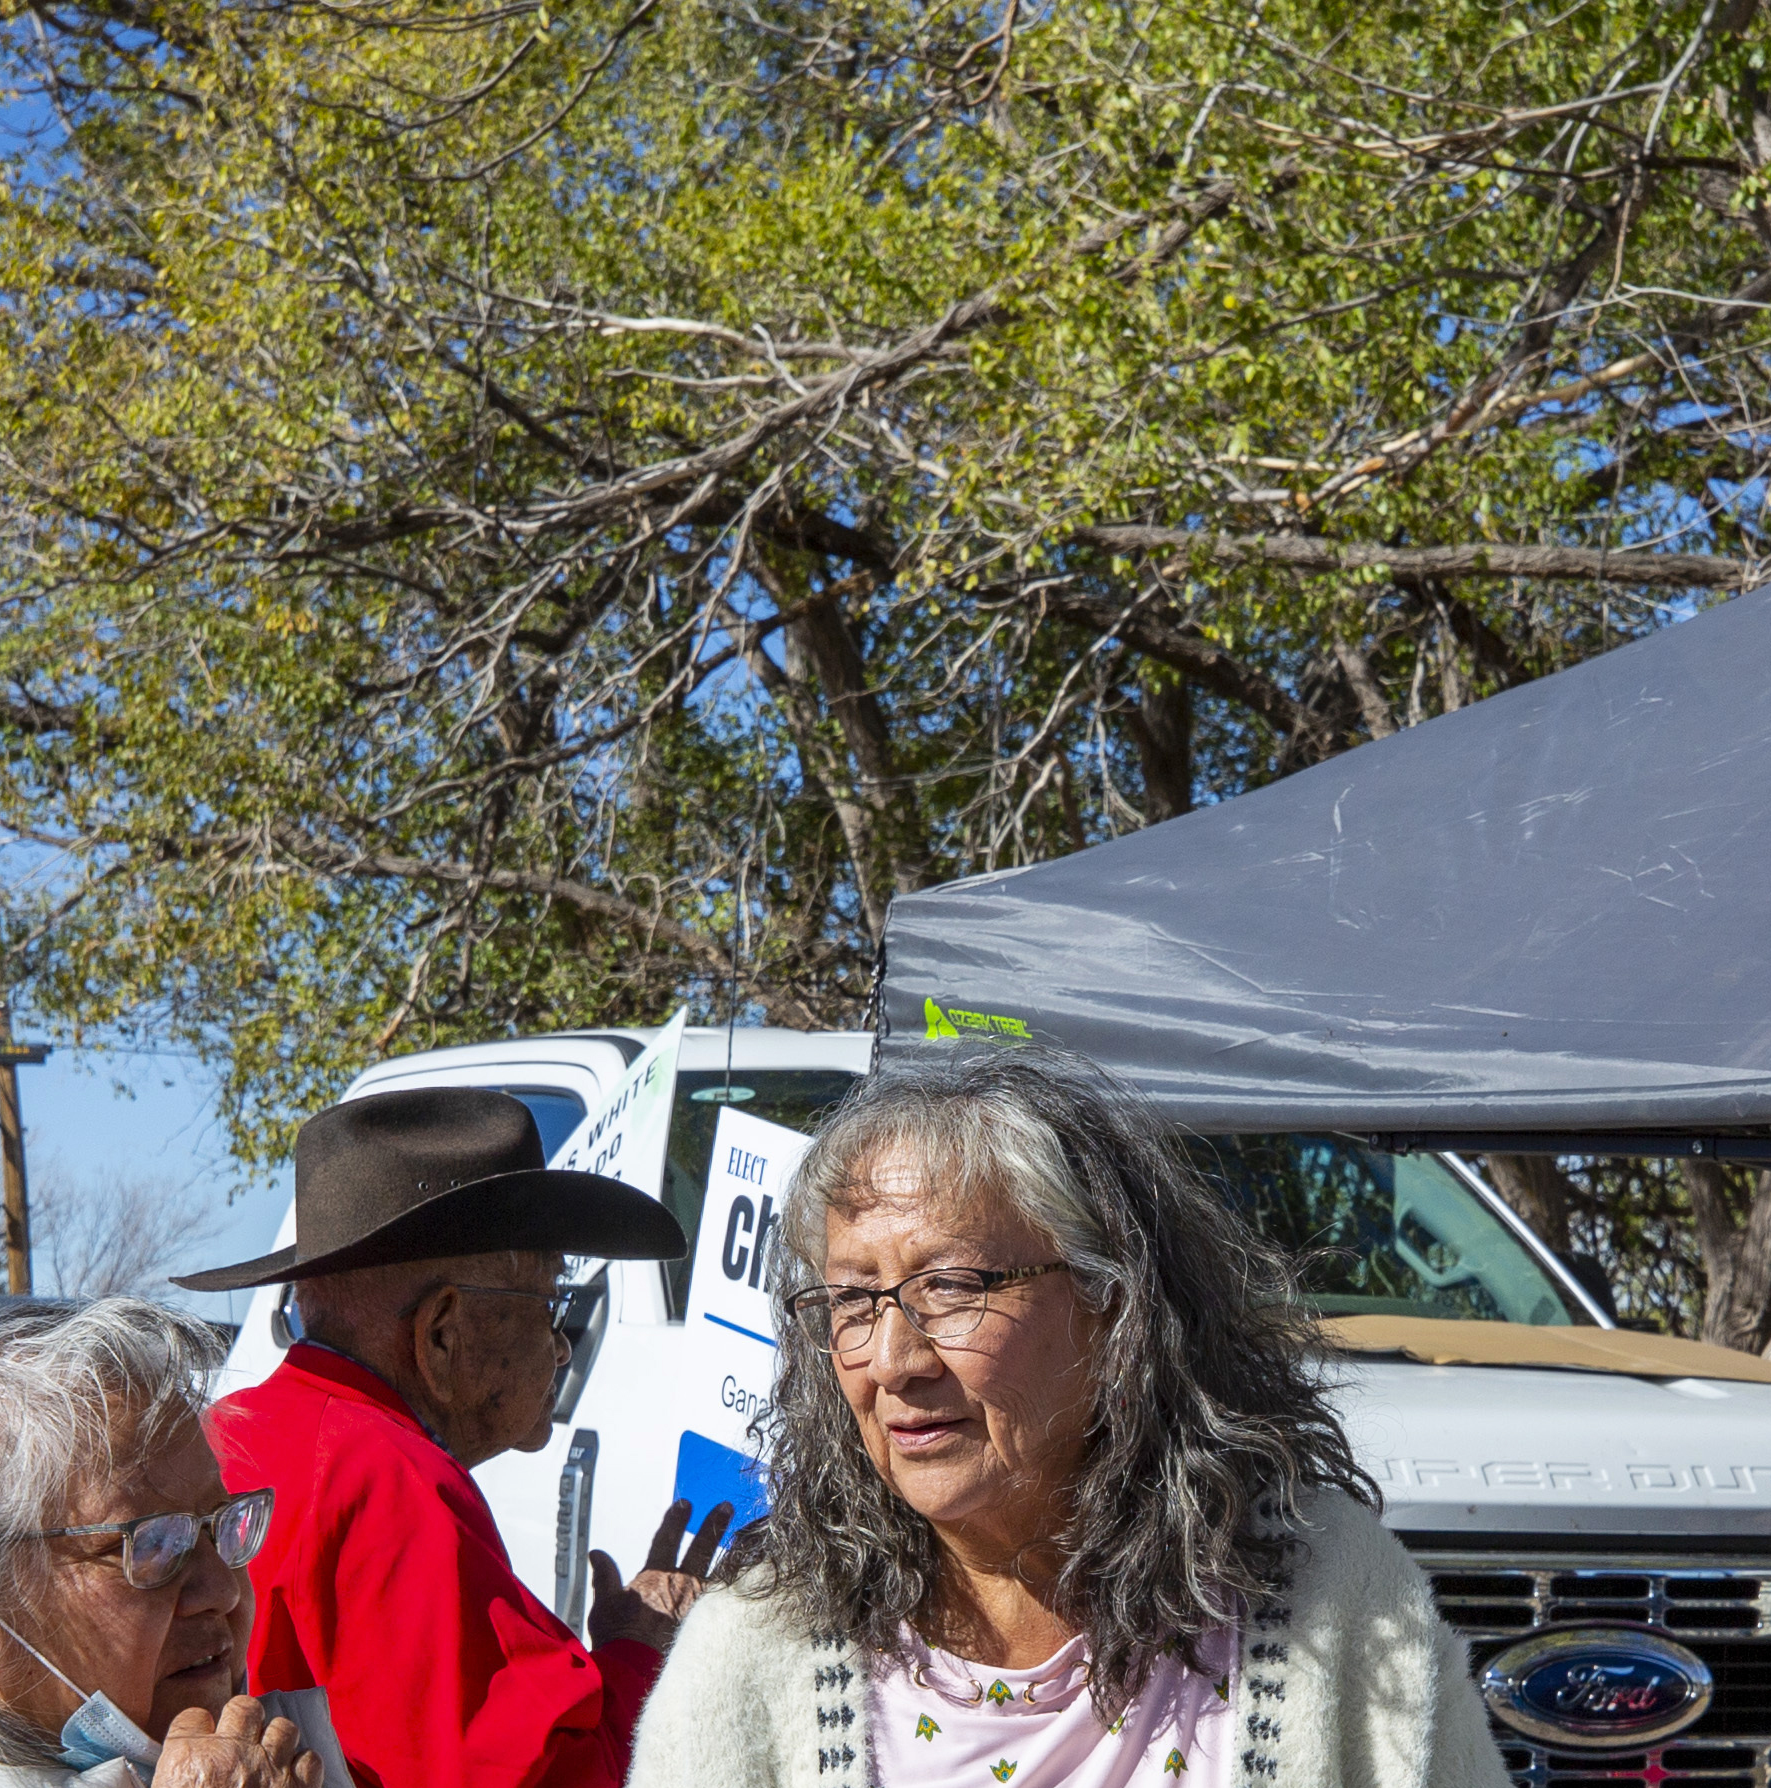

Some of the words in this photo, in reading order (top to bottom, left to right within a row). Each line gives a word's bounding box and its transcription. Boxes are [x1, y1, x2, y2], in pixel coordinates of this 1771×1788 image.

[588, 1056, 659, 1149] WHITE
[726, 1146, 768, 1186] ELECT
[1556, 1662, 1661, 1711] Ford
